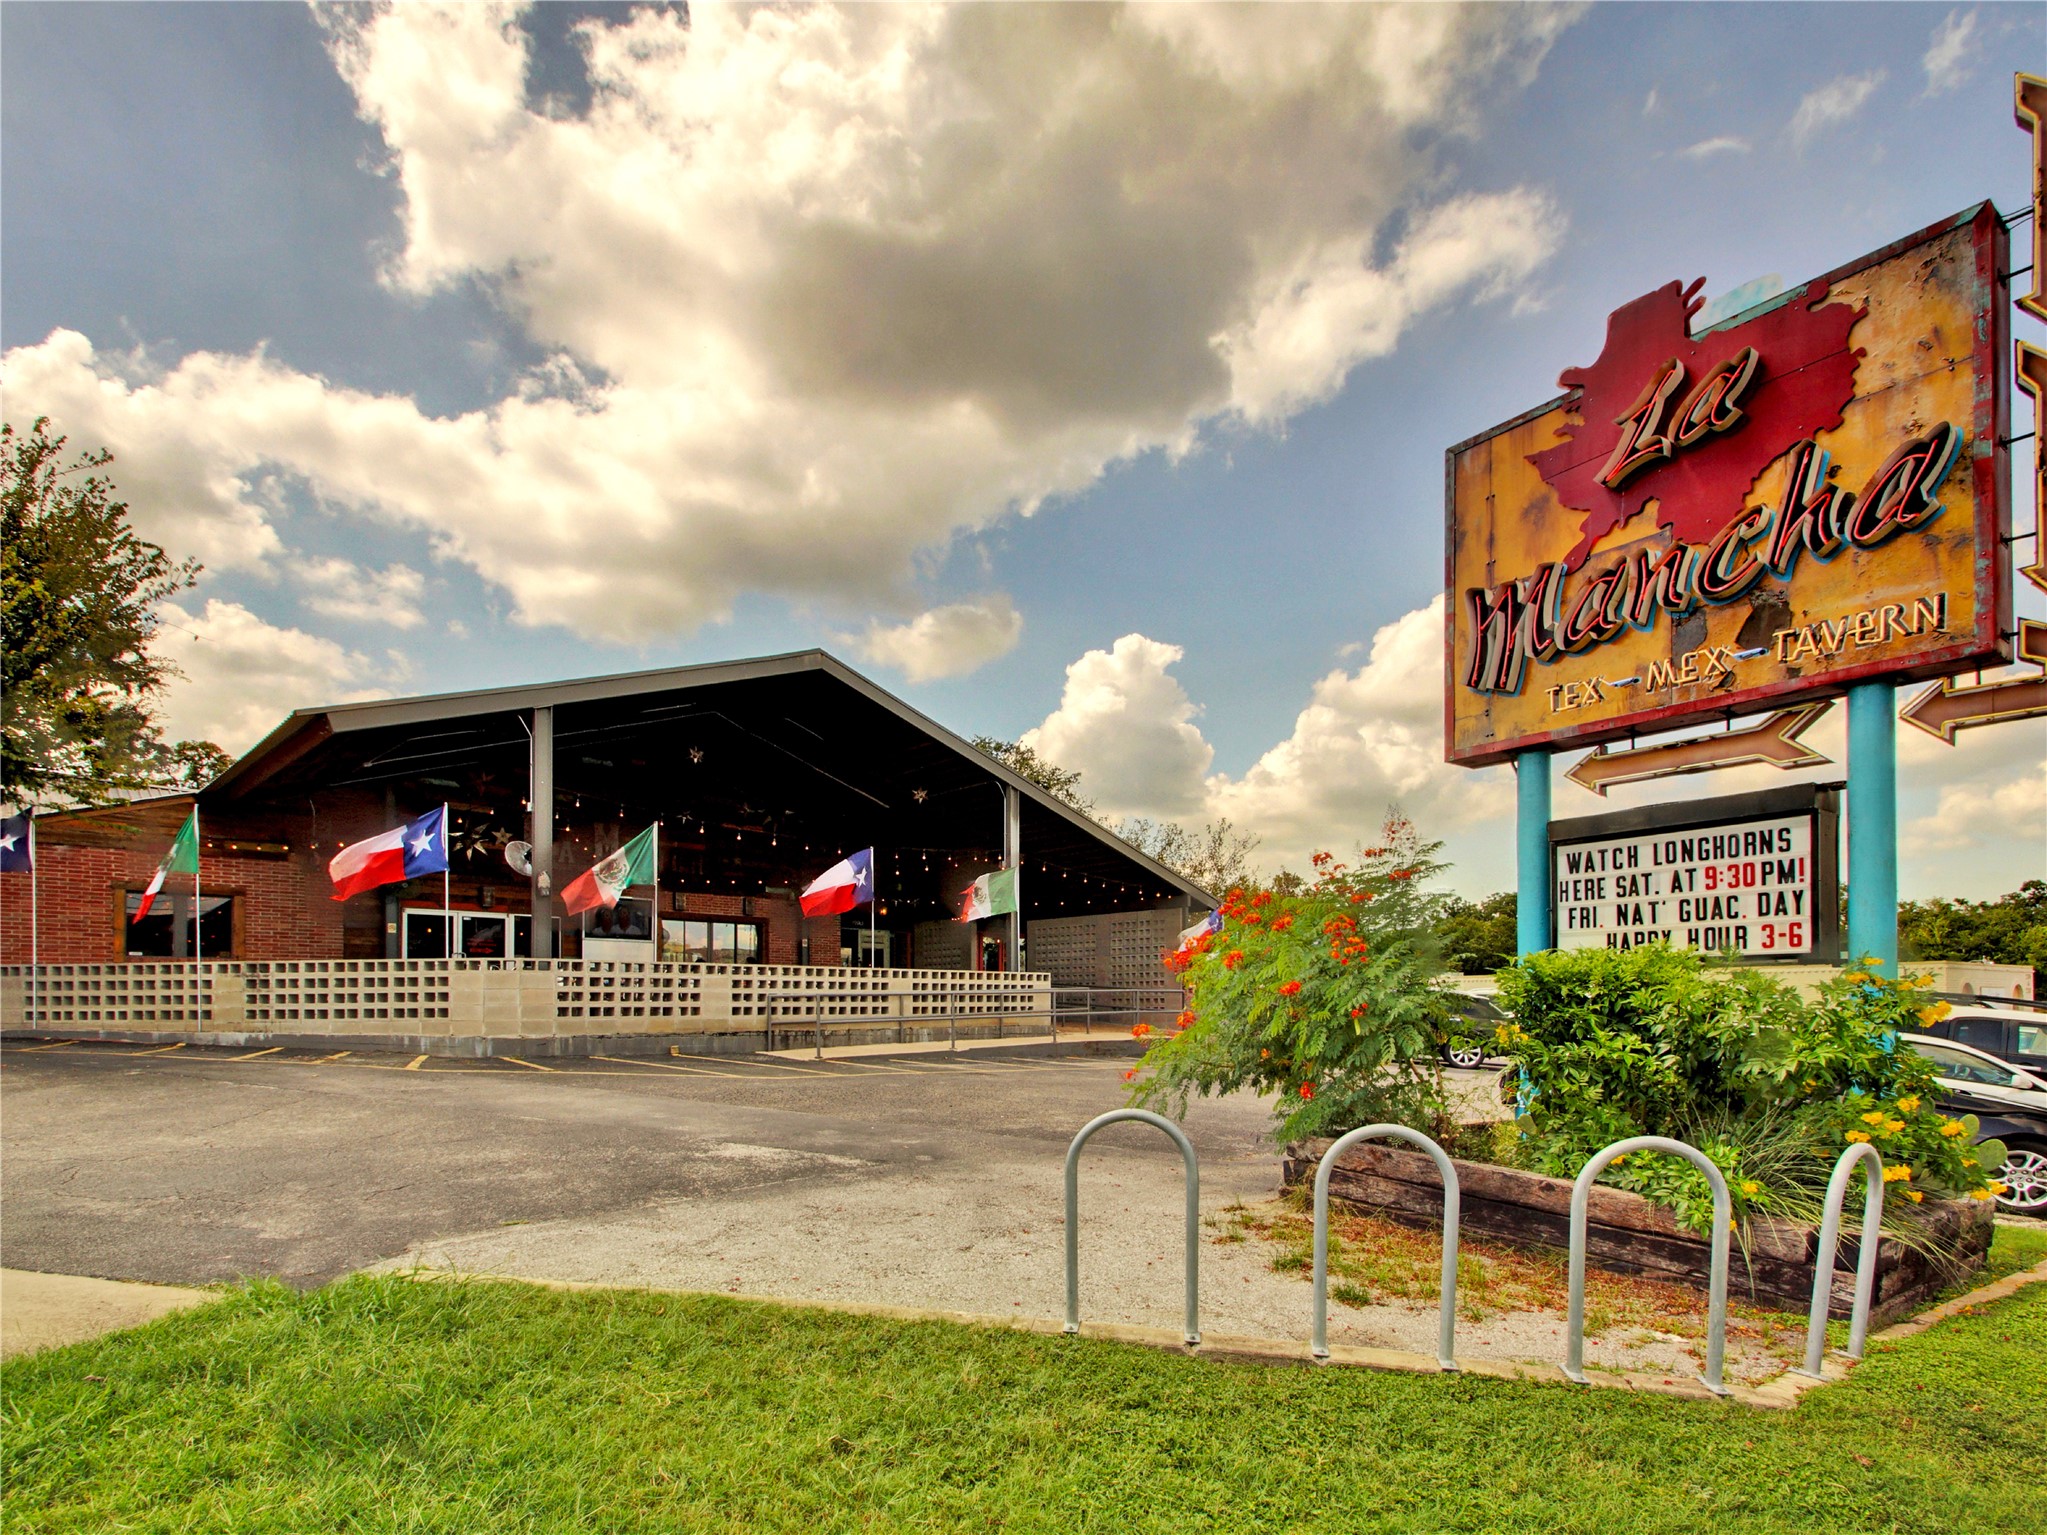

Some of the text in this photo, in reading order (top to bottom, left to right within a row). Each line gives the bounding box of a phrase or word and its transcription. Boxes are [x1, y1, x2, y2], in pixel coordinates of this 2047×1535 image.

[1593, 345, 1759, 489] La
[1465, 421, 1959, 694] Mancha
[1545, 676, 1602, 712] TEX
[1646, 646, 1732, 692] MEX
[1566, 827, 1791, 874] WATCH LONGHORNS
[1559, 877, 1606, 902] HERE
[1616, 873, 1659, 898] SAT.
[1671, 868, 1697, 893] AT
[1569, 906, 1603, 929] FRI.
[1679, 895, 1747, 922] GUAC.
[1758, 890, 1804, 917] DAY
[1688, 925, 1748, 951] HOUR
[1762, 922, 1803, 949] 3-6
